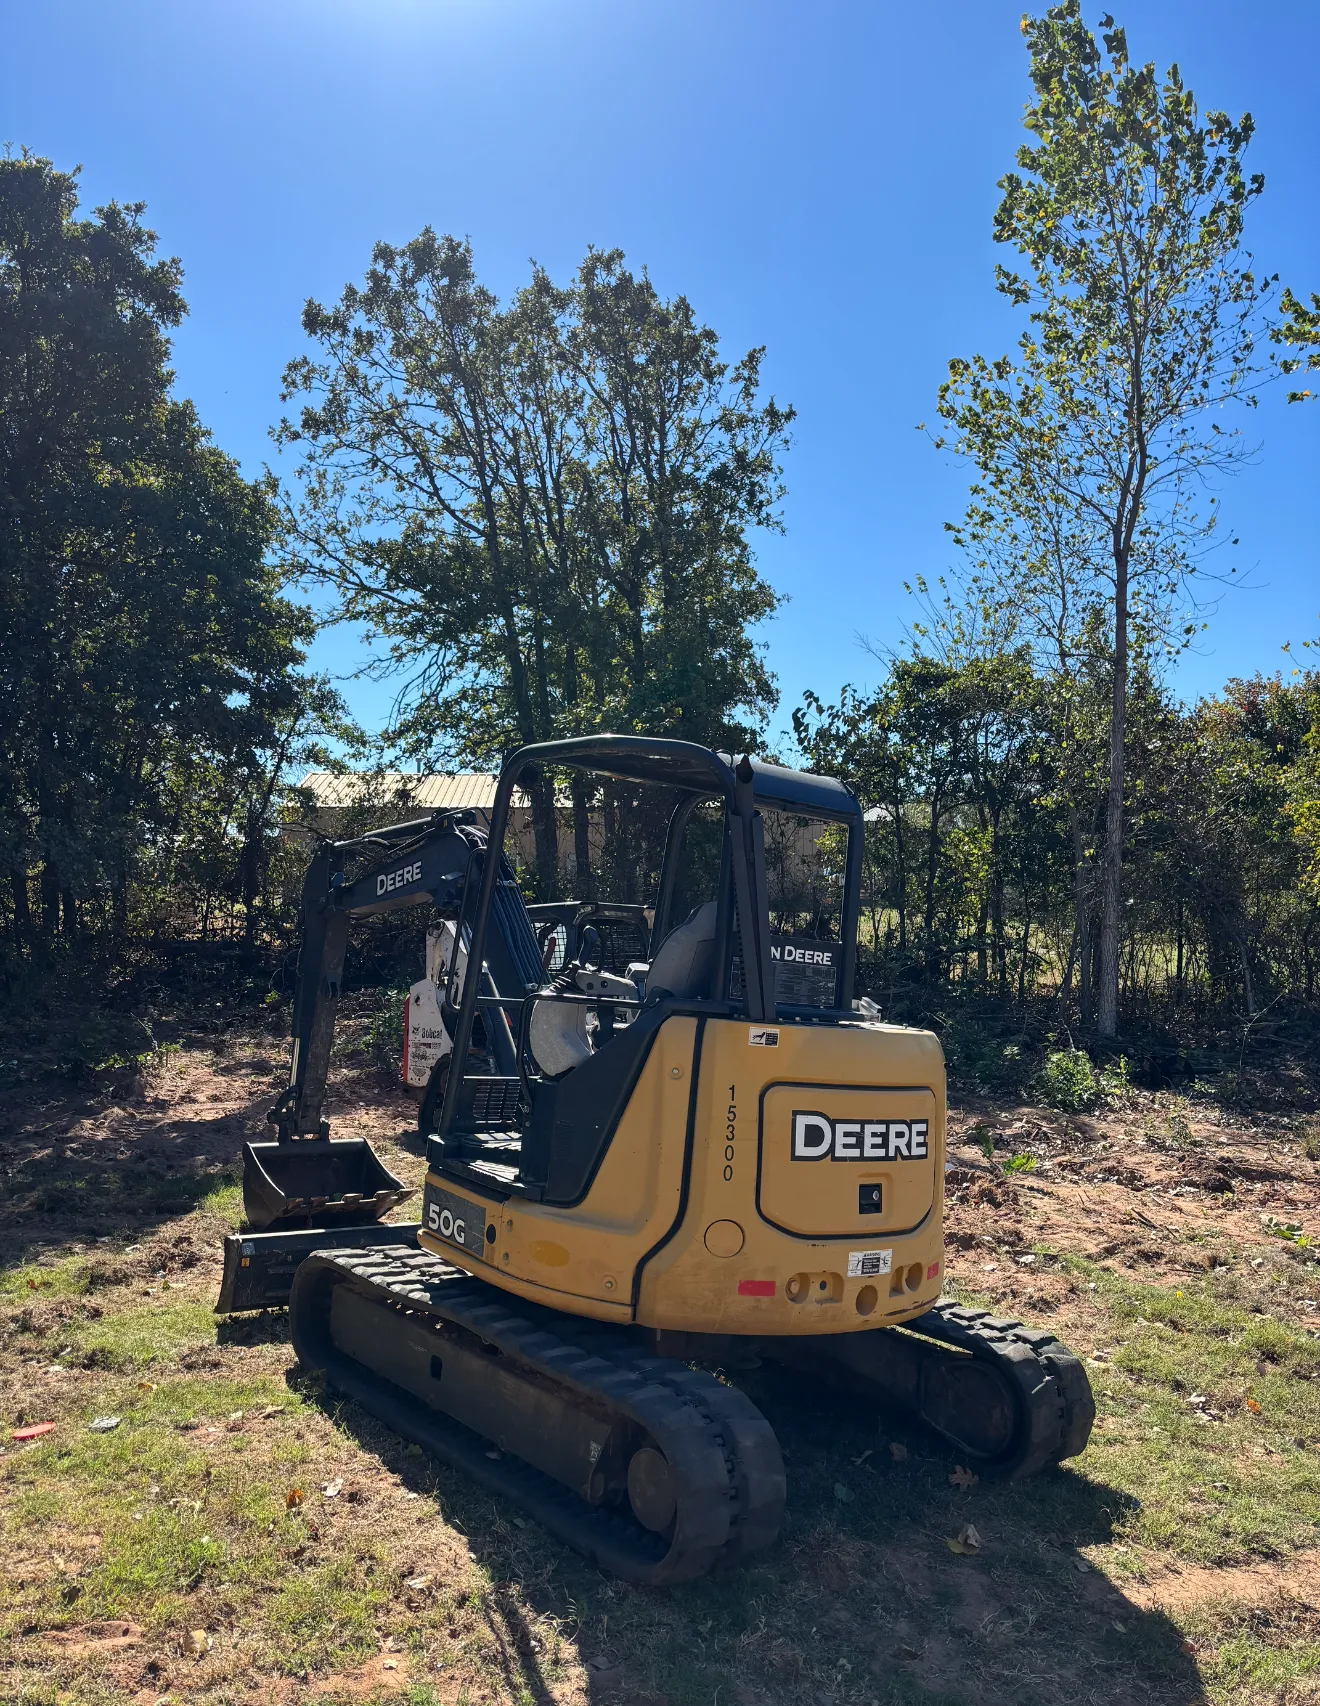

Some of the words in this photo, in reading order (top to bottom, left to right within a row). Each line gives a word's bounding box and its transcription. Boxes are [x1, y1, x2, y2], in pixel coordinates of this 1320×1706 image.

[376, 860, 422, 896] DEERE
[784, 945, 832, 965] DEERE
[723, 1084, 736, 1182] 15300
[794, 1114, 927, 1157] DEERE
[428, 1202, 465, 1244] 50G
